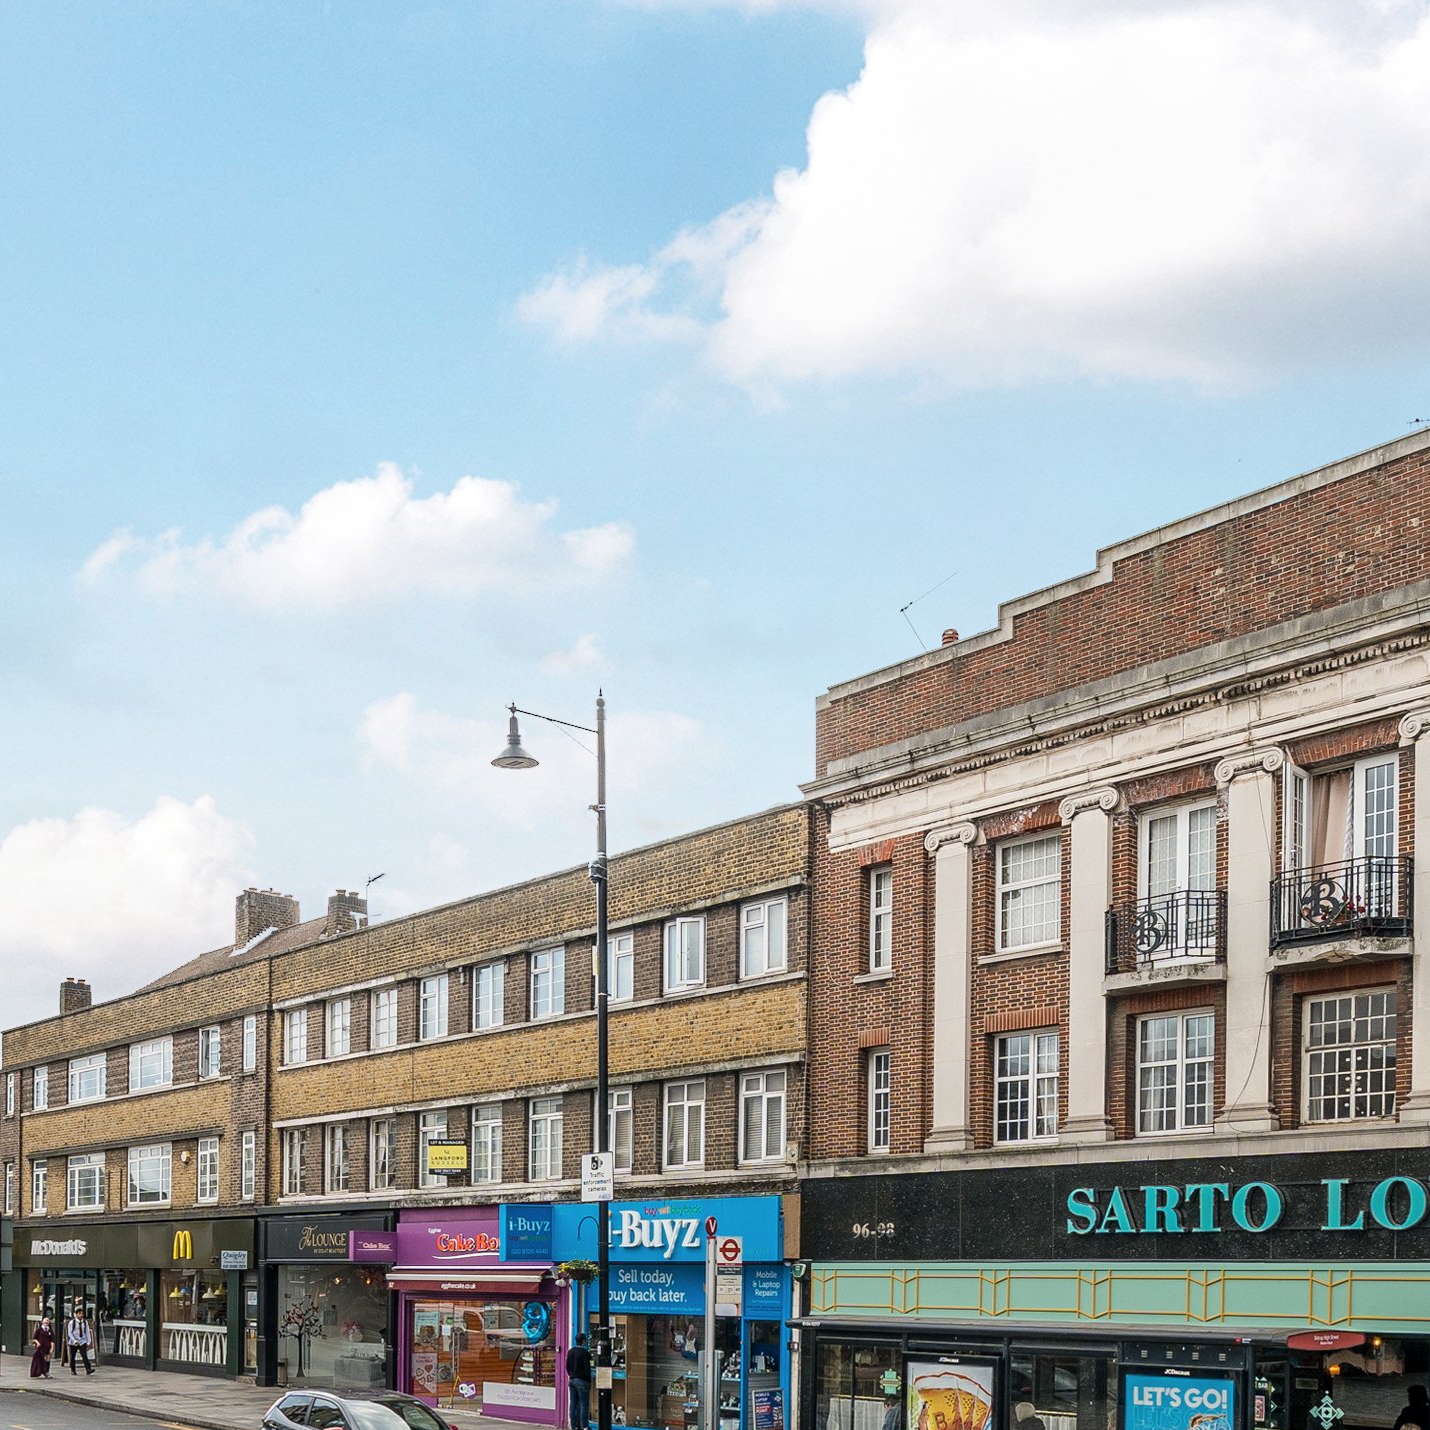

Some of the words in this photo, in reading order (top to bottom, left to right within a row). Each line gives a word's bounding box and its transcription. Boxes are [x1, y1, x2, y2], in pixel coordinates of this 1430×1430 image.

[644, 1206, 658, 1215] buy
[670, 1204, 700, 1214] buyback
[1066, 1183, 1283, 1235] SARTO
[508, 1217, 550, 1235] i-Buyz
[708, 1219, 717, 1233] V
[852, 1222, 896, 1240] 96-98
[311, 1232, 346, 1247] LOUNGE
[436, 1232, 475, 1252] Cake
[475, 1232, 499, 1252] Bo
[31, 1239, 88, 1256] McDonald's
[222, 1251, 247, 1261] Quigley
[618, 1269, 638, 1284] Sell
[640, 1269, 675, 1287] today,
[758, 1280, 781, 1289] Laptop
[628, 1287, 657, 1301] back
[658, 1288, 688, 1303] later.
[754, 1289, 778, 1298] Repairs
[939, 1356, 960, 1364] JCDecaux
[1164, 1368, 1190, 1376] JCDecaux
[1133, 1386, 1181, 1408] LET'S
[1184, 1387, 1228, 1409] GO!
